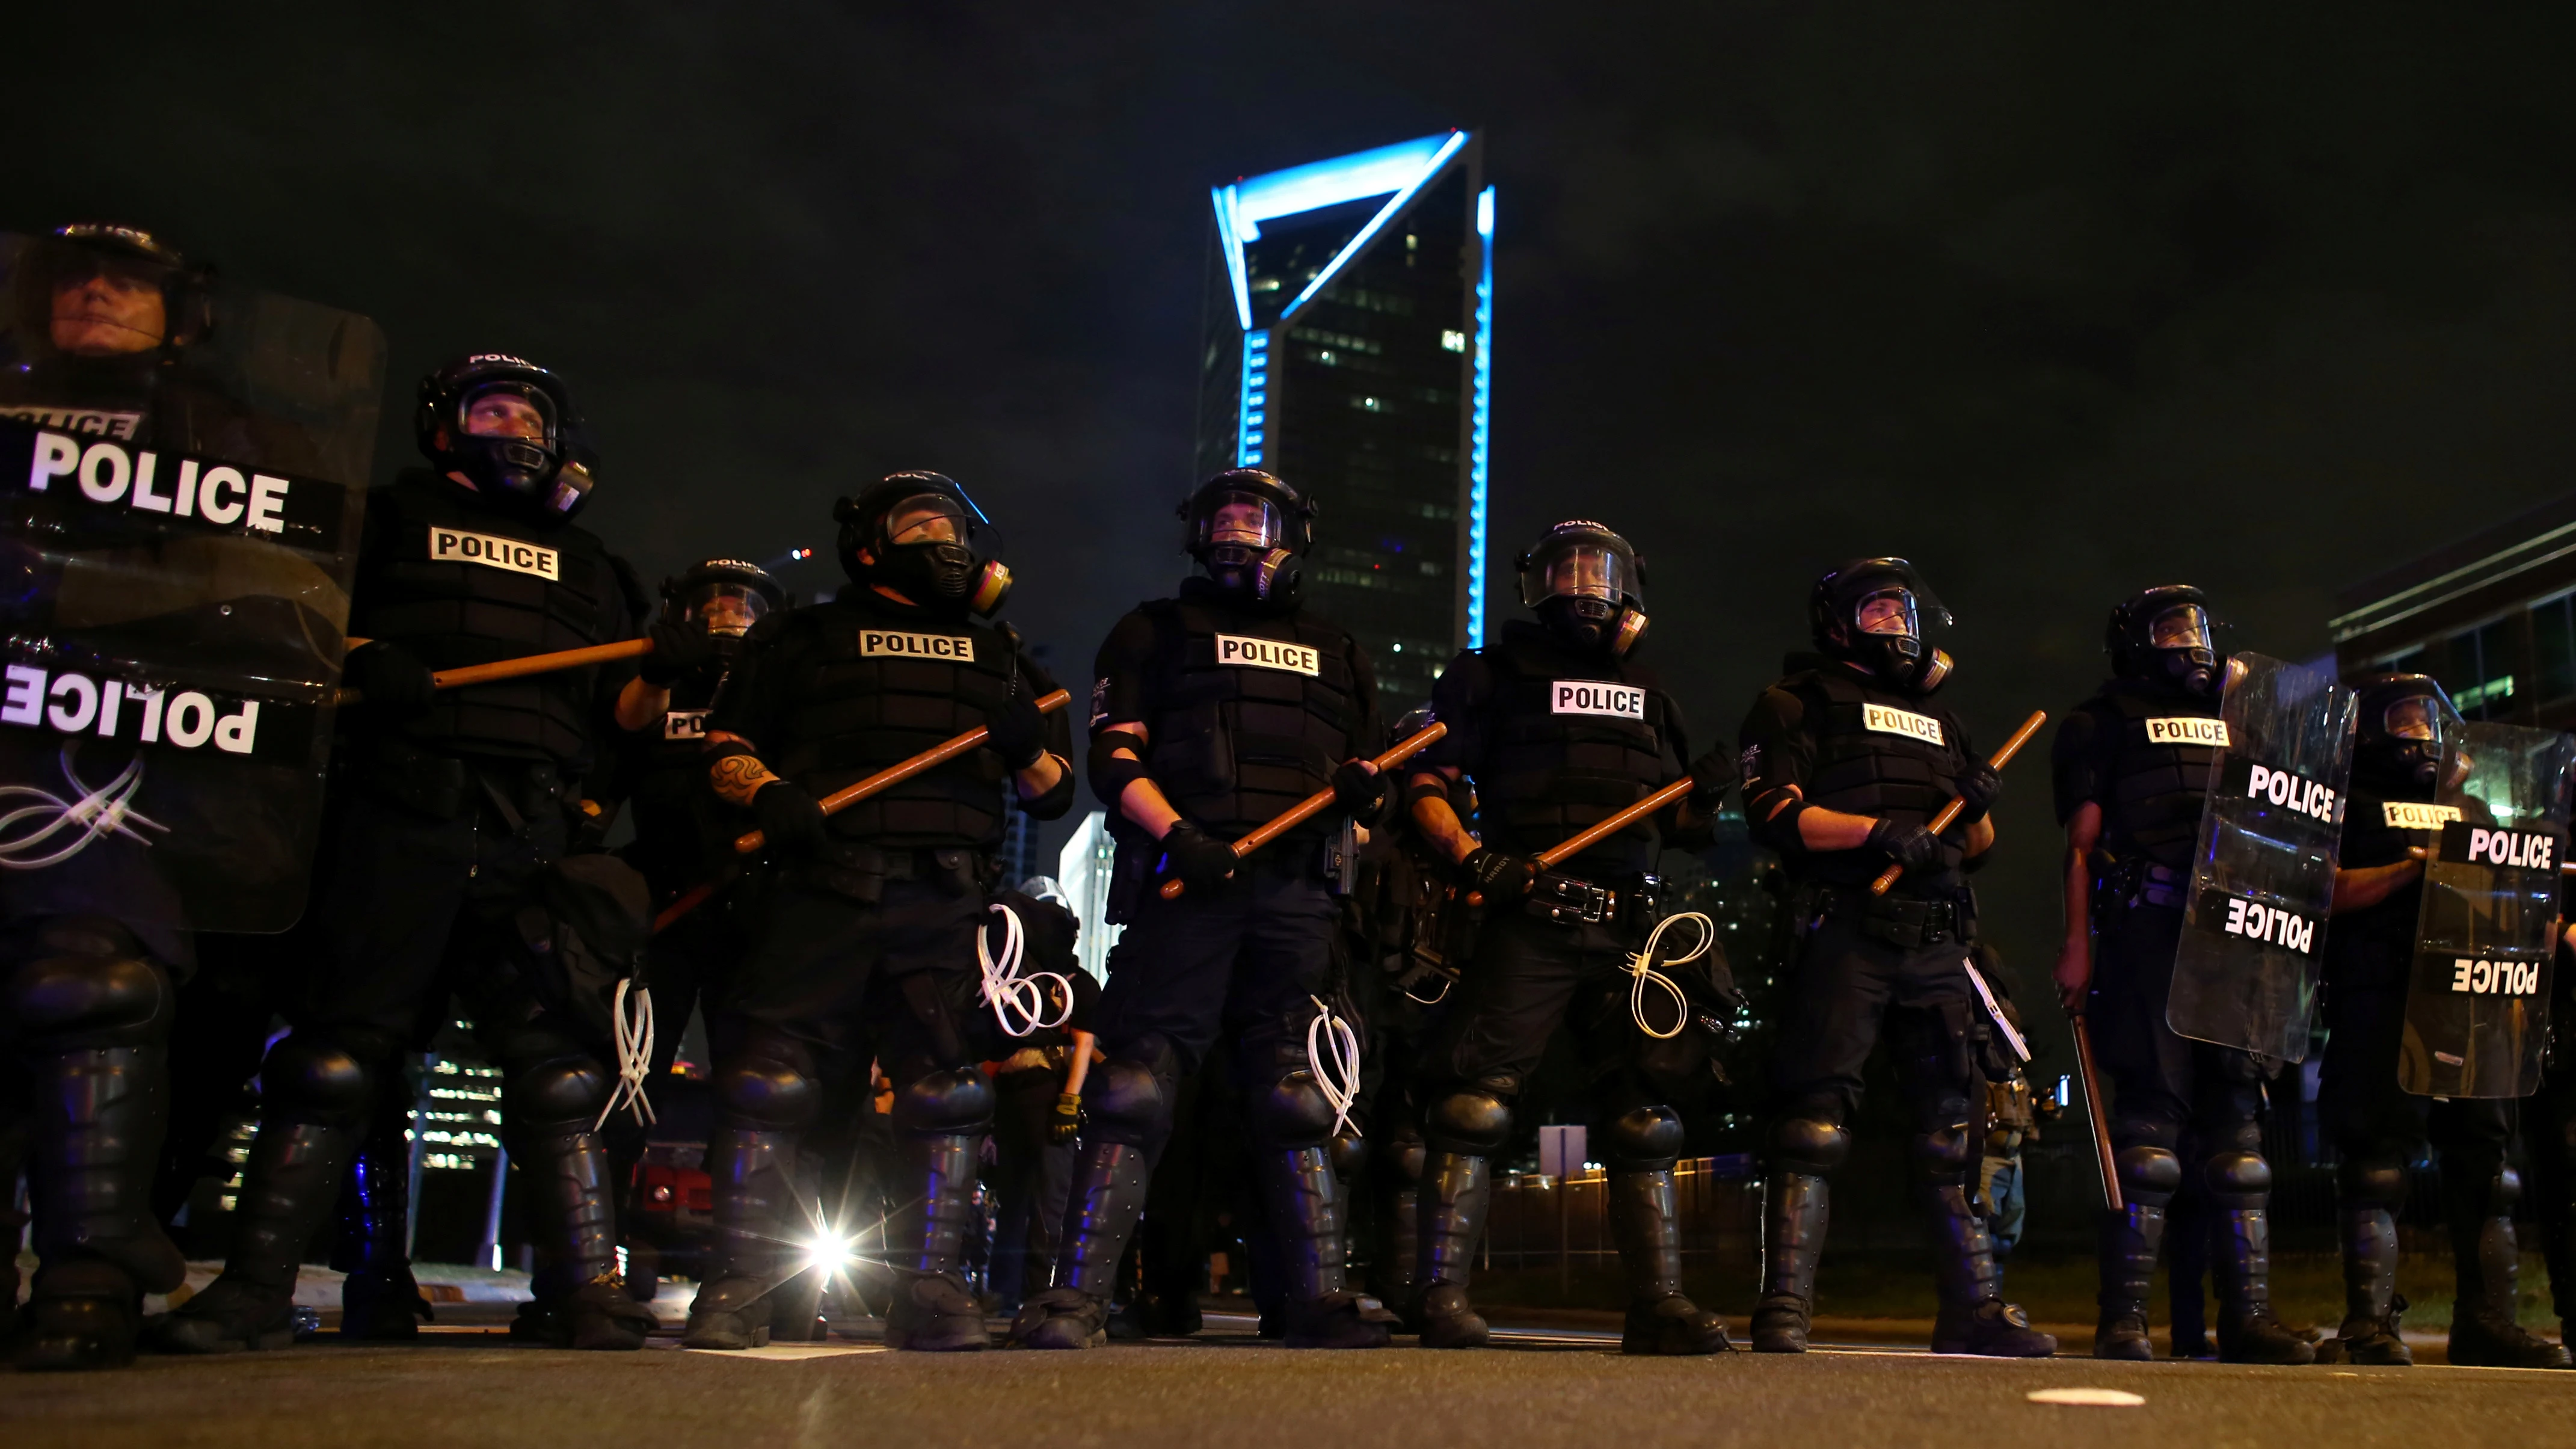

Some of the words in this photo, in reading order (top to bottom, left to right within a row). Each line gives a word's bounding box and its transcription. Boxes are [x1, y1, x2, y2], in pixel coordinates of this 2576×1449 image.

[29, 431, 289, 534] POLICE
[438, 533, 552, 573] POLICE
[866, 634, 968, 657] POLICE
[1223, 640, 1314, 670] POLICE
[0, 664, 260, 754] POLICE
[1559, 687, 1640, 713] POLICE
[1869, 709, 1938, 740] POLICE
[2153, 722, 2225, 741] POLICE
[2247, 764, 2335, 823] POLICE
[2468, 828, 2554, 870] POLICE
[2224, 897, 2314, 955] POLICE
[2452, 958, 2539, 995] POLICE
